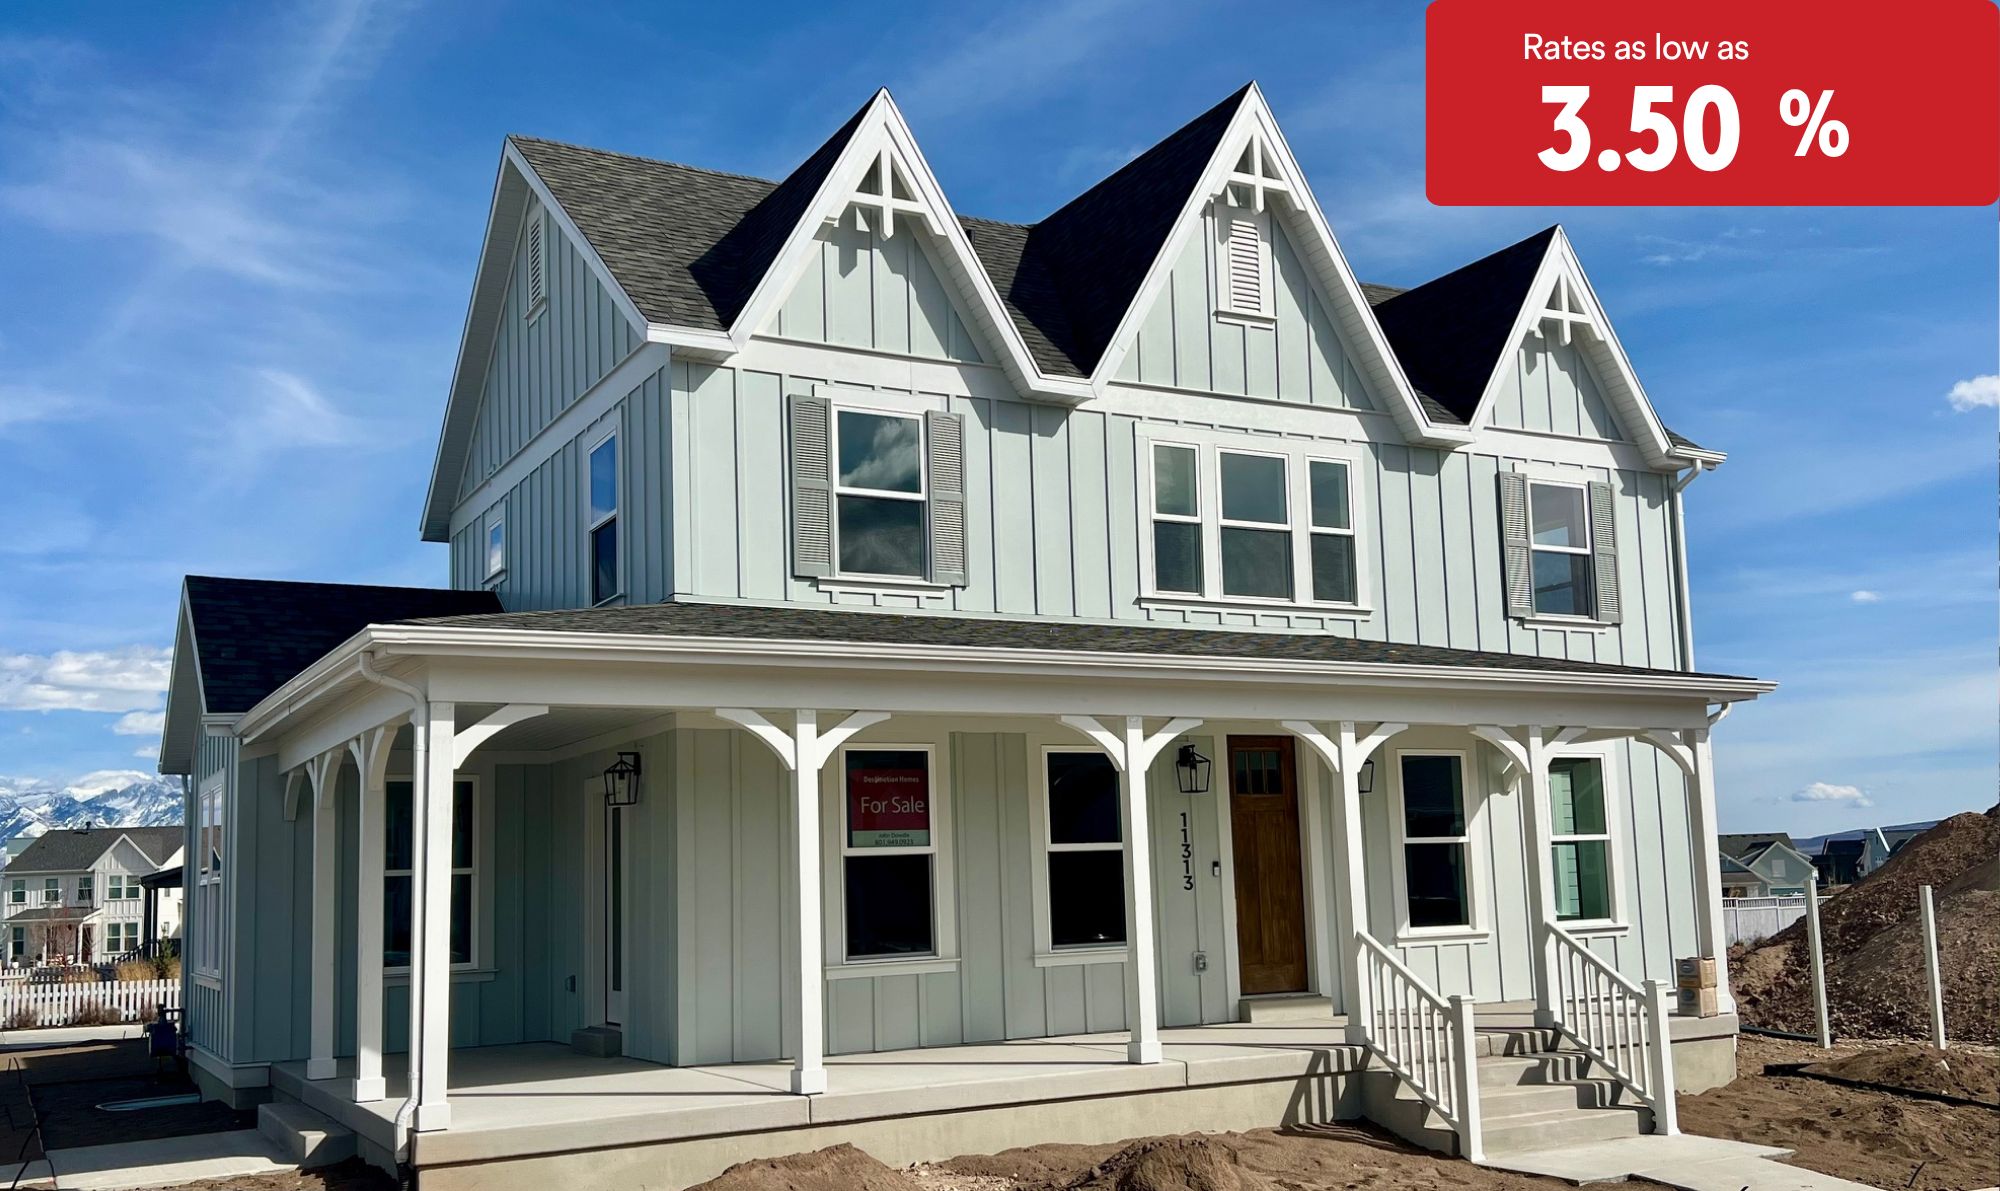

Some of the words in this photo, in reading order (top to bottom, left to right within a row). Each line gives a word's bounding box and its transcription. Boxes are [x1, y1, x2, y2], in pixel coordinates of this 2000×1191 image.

[861, 796, 888, 814] For
[891, 795, 925, 814] Sale
[1180, 812, 1194, 891] 11313
